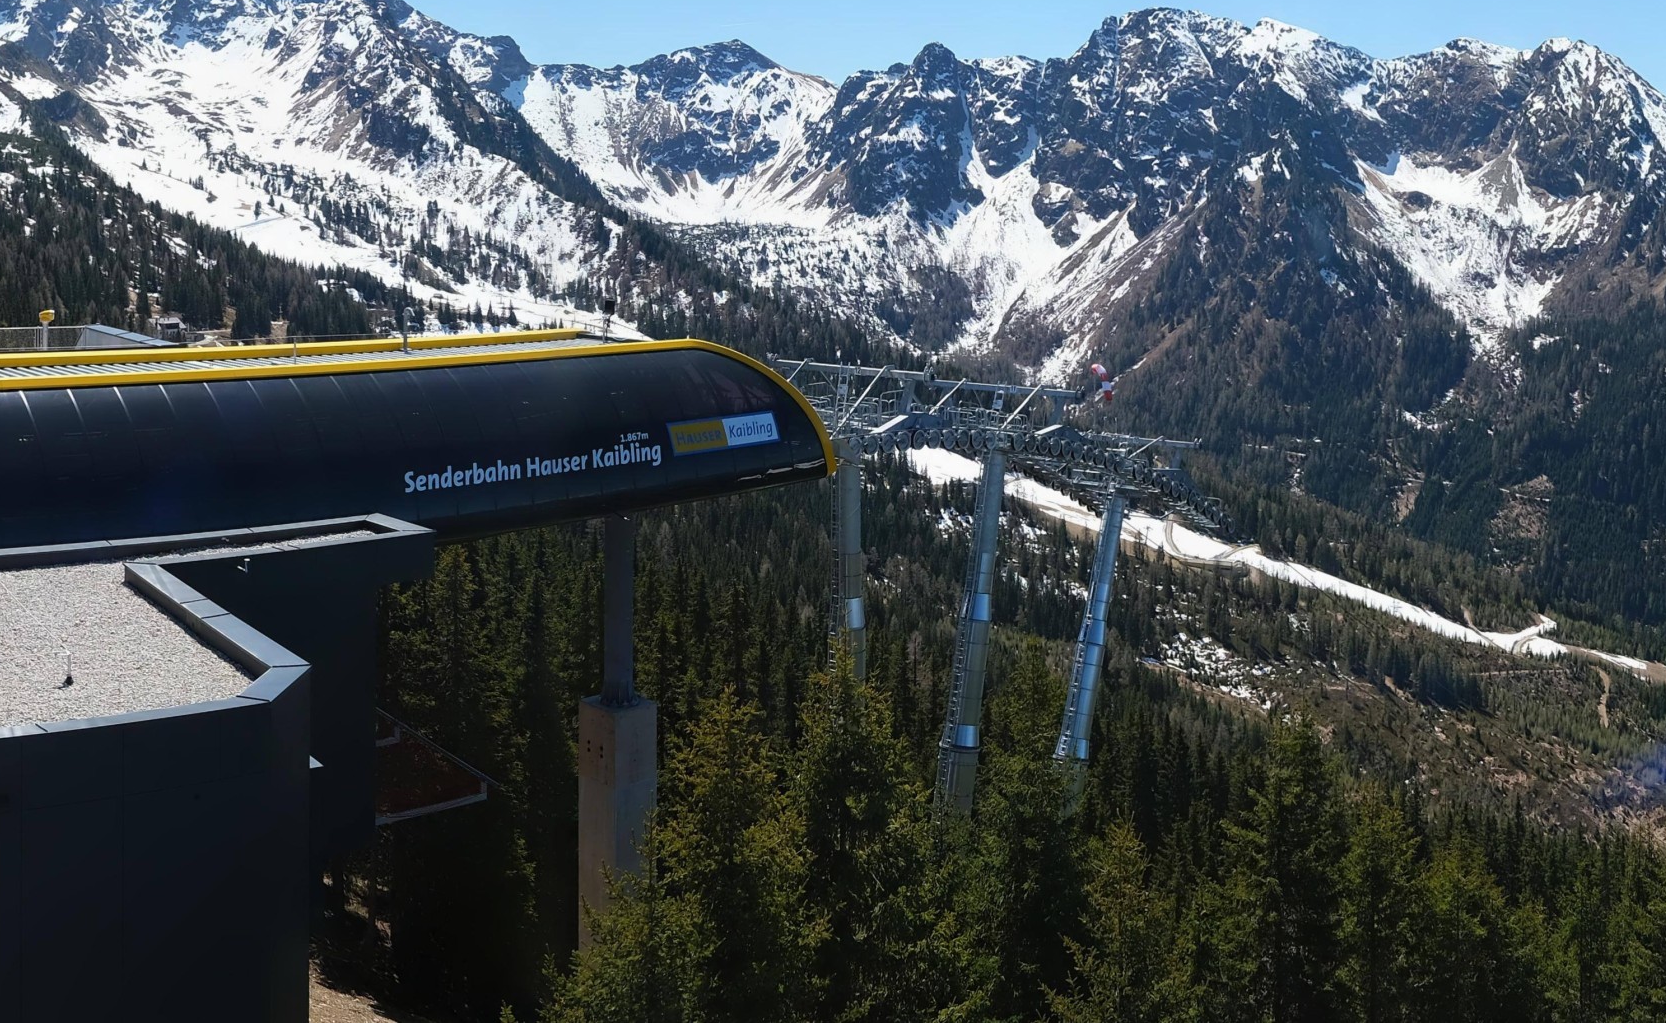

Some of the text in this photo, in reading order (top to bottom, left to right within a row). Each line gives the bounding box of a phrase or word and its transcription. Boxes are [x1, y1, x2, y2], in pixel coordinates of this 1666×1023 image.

[619, 431, 649, 443] 1.867m
[728, 421, 773, 439] Kaibling
[404, 442, 662, 493] Senderbahn Hauser Kaibling
